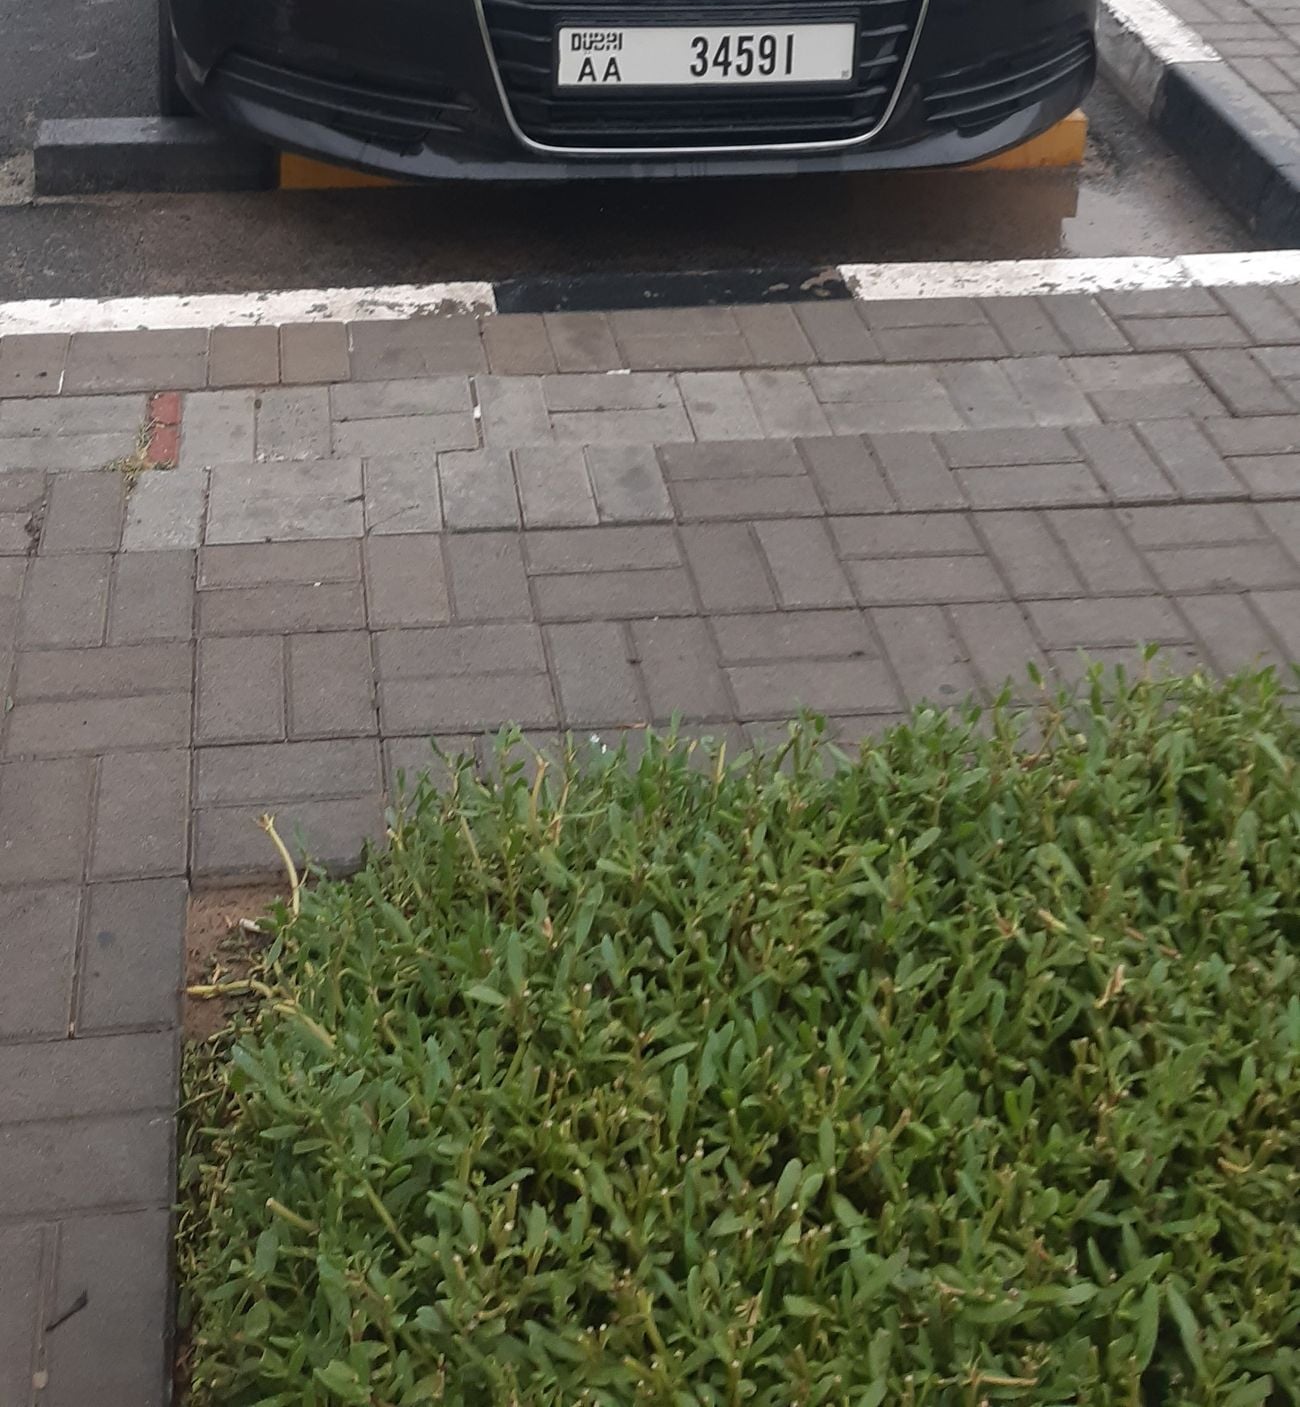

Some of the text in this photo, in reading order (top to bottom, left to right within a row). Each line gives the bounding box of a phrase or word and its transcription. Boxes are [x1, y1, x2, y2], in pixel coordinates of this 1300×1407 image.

[571, 32, 623, 51] DUBAI
[690, 33, 794, 77] 34591
[577, 56, 621, 82] AA
